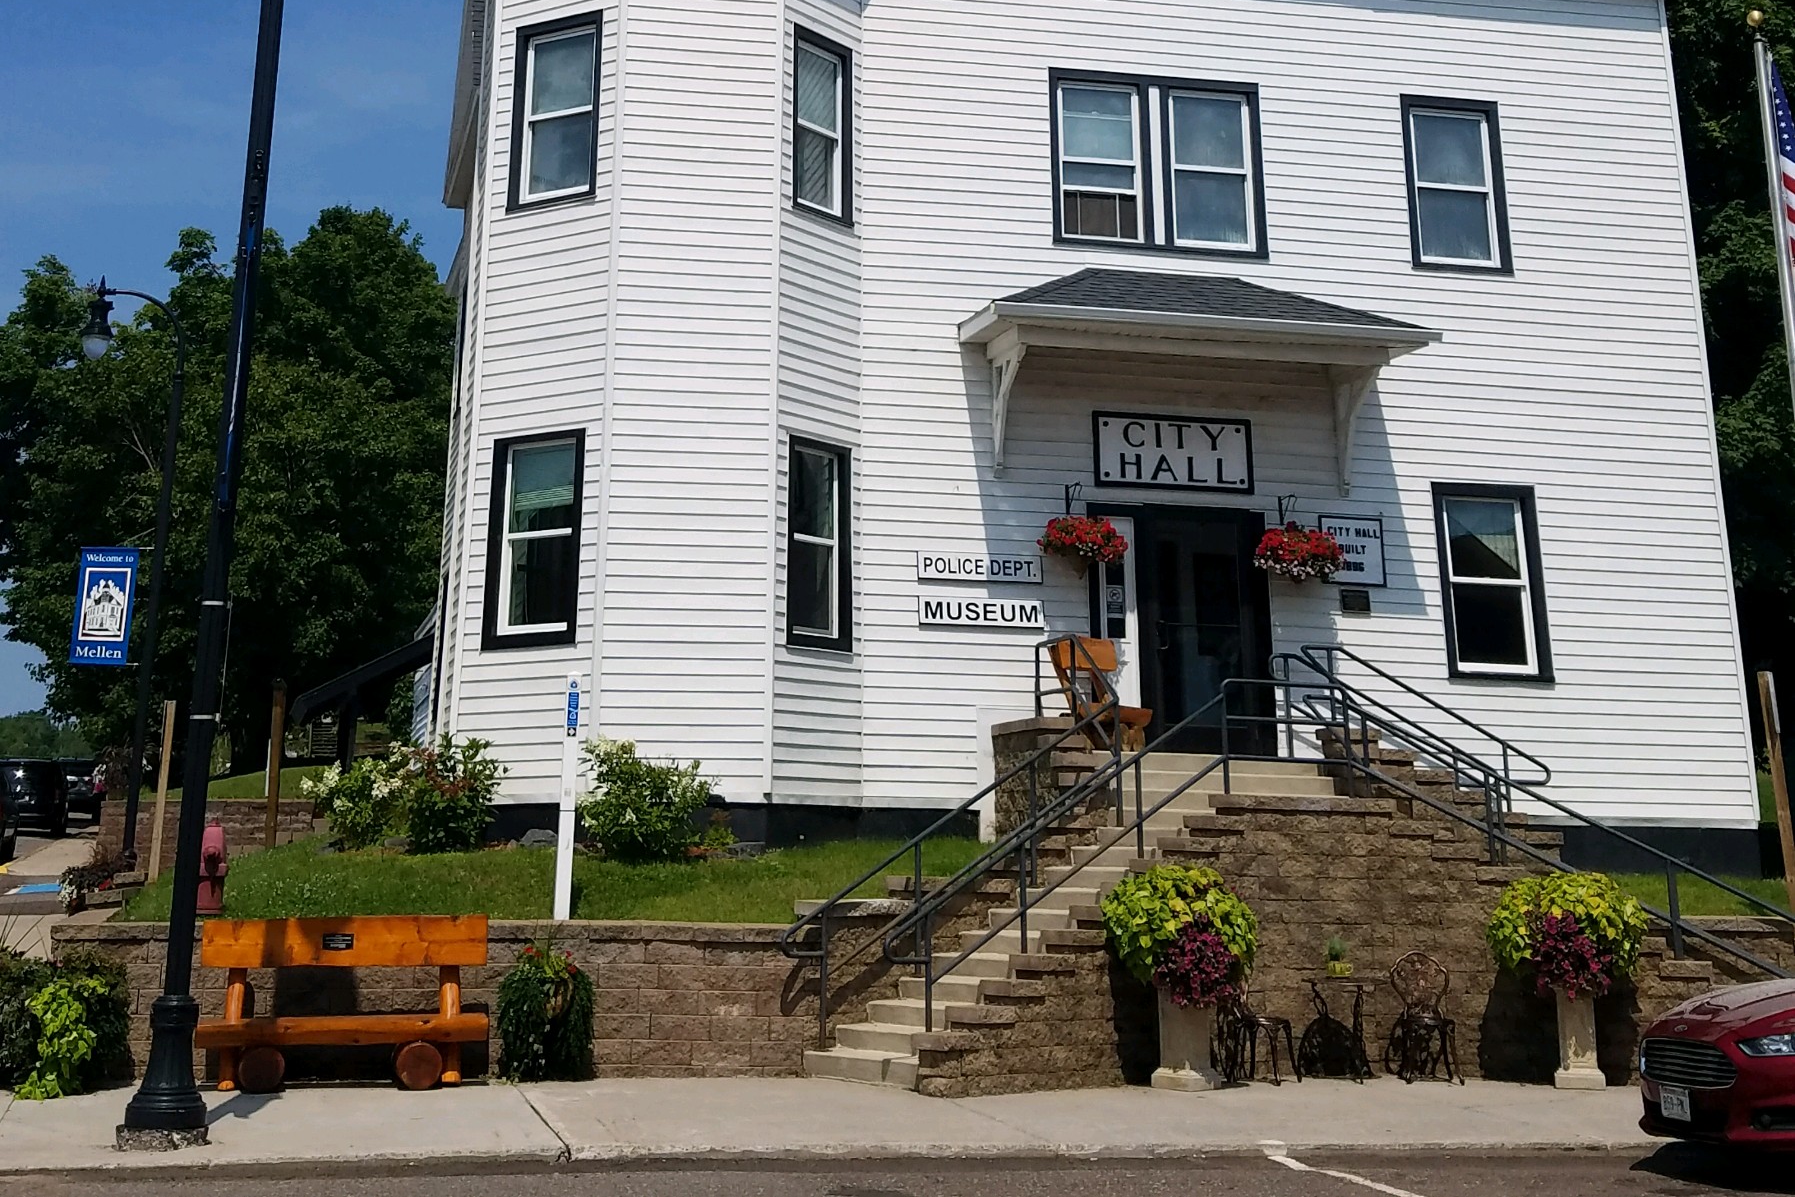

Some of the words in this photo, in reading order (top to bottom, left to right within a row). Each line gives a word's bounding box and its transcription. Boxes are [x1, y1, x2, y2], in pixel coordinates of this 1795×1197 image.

[1122, 421, 1225, 451] CITY
[1119, 453, 1237, 485] HALL
[1327, 526, 1350, 537] CITY
[1355, 527, 1380, 539] HALL
[86, 553, 124, 563] Welcome
[125, 555, 134, 563] to
[923, 557, 985, 575] POLICE
[990, 559, 1037, 578] DEPT.
[924, 600, 1039, 624] MUSEUM
[75, 645, 122, 659] Mellen
